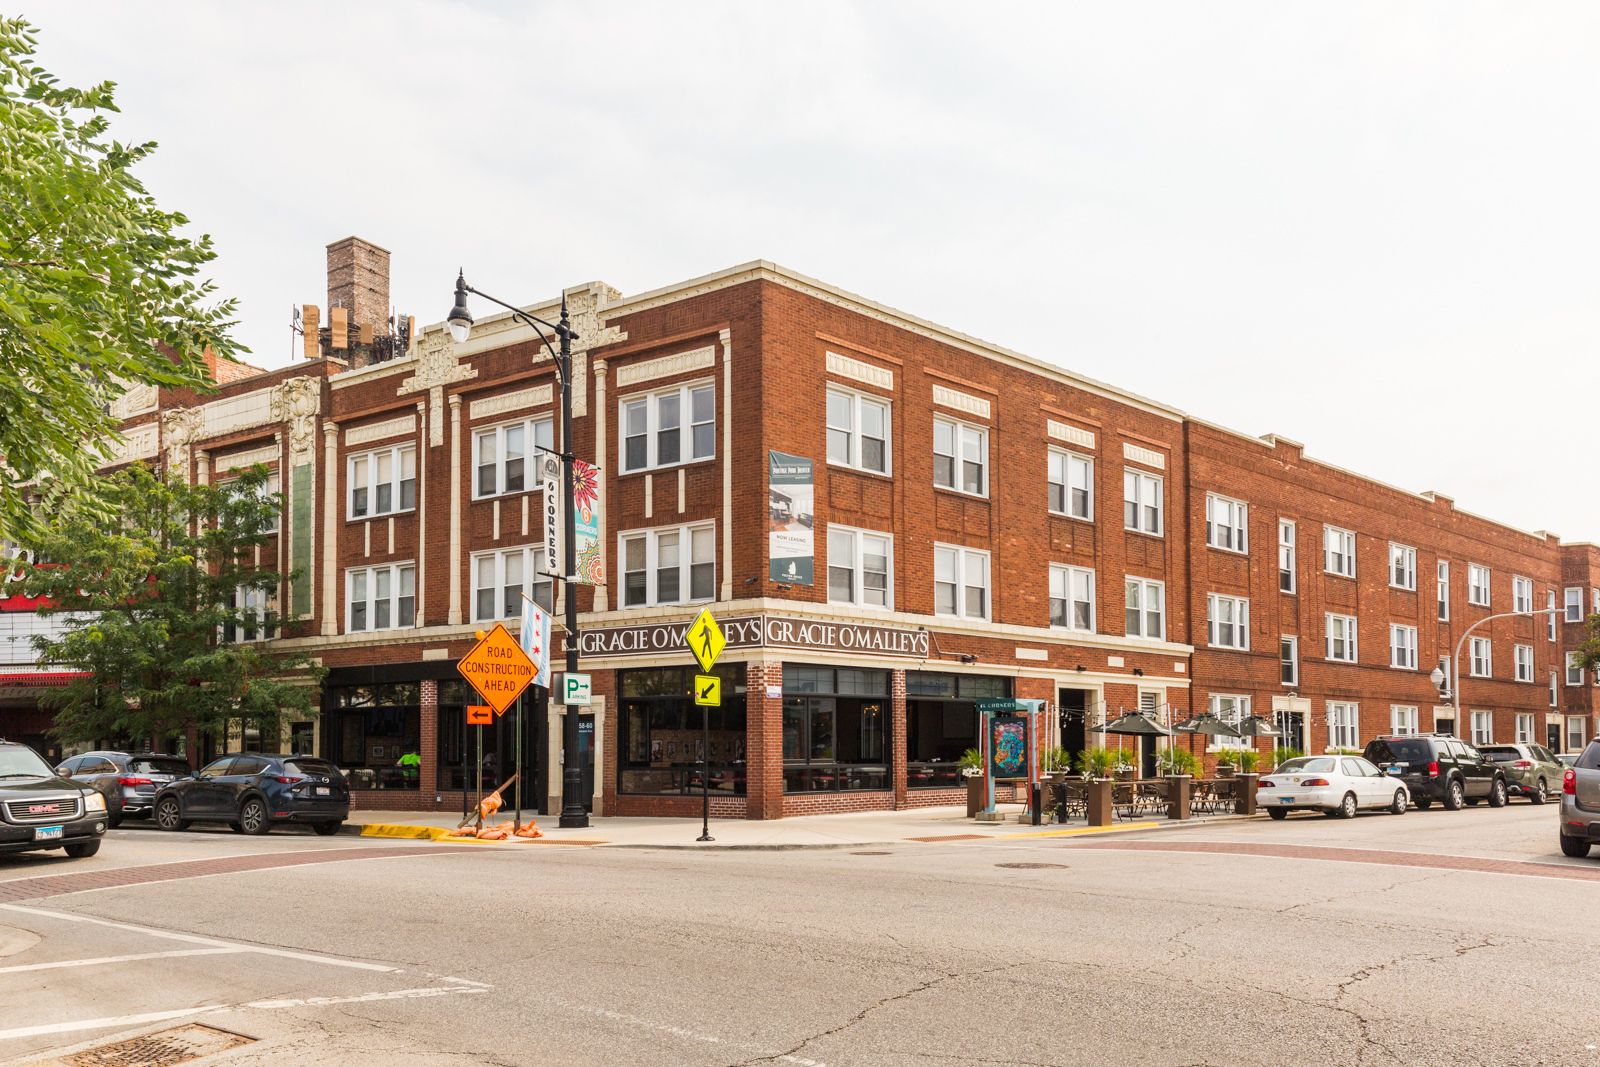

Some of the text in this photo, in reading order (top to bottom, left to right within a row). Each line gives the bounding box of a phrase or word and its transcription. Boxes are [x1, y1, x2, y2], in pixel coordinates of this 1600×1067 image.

[548, 482, 554, 491] 6
[548, 494, 556, 569] CORNERS
[581, 619, 761, 652] GRACIE O'MEY'S
[767, 620, 928, 653] GRACIE O'MALLEY'S
[487, 646, 513, 659] ROAD
[465, 661, 532, 676] CONSTRUCTION
[484, 680, 516, 692] AHEAD
[29, 804, 60, 813] GMC
